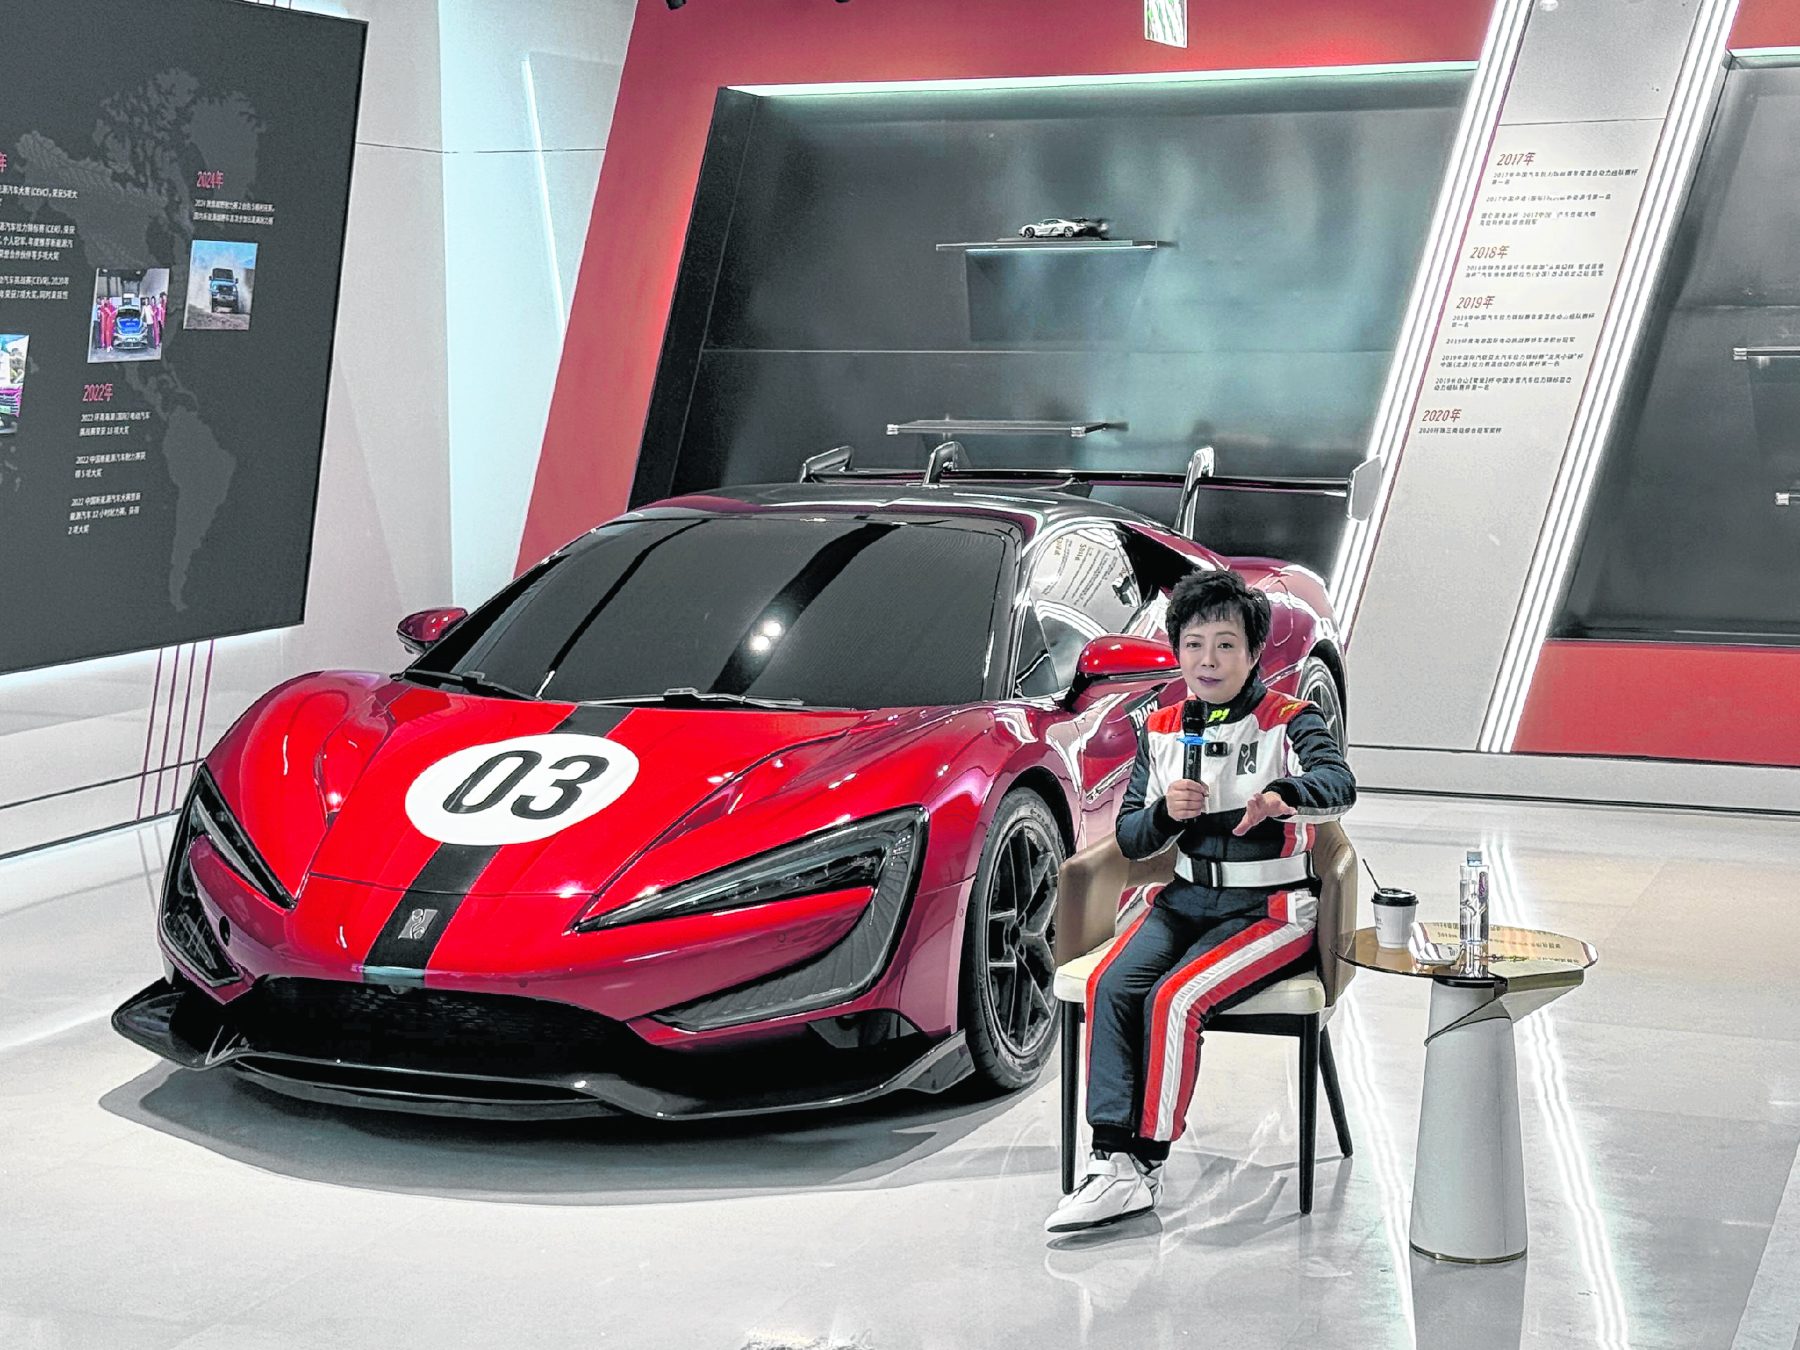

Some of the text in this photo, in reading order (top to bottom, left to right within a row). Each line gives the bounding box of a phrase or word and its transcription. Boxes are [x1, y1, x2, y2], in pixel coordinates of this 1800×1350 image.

[1496, 152, 1536, 167] 2017年
[196, 171, 224, 189] 2024年
[1469, 245, 1510, 260] 2018年
[1455, 295, 1496, 310] 2019年
[82, 383, 113, 402] 2022年
[1421, 408, 1462, 422] 2020年
[1129, 700, 1159, 730] TRACK
[442, 749, 610, 820] 03
